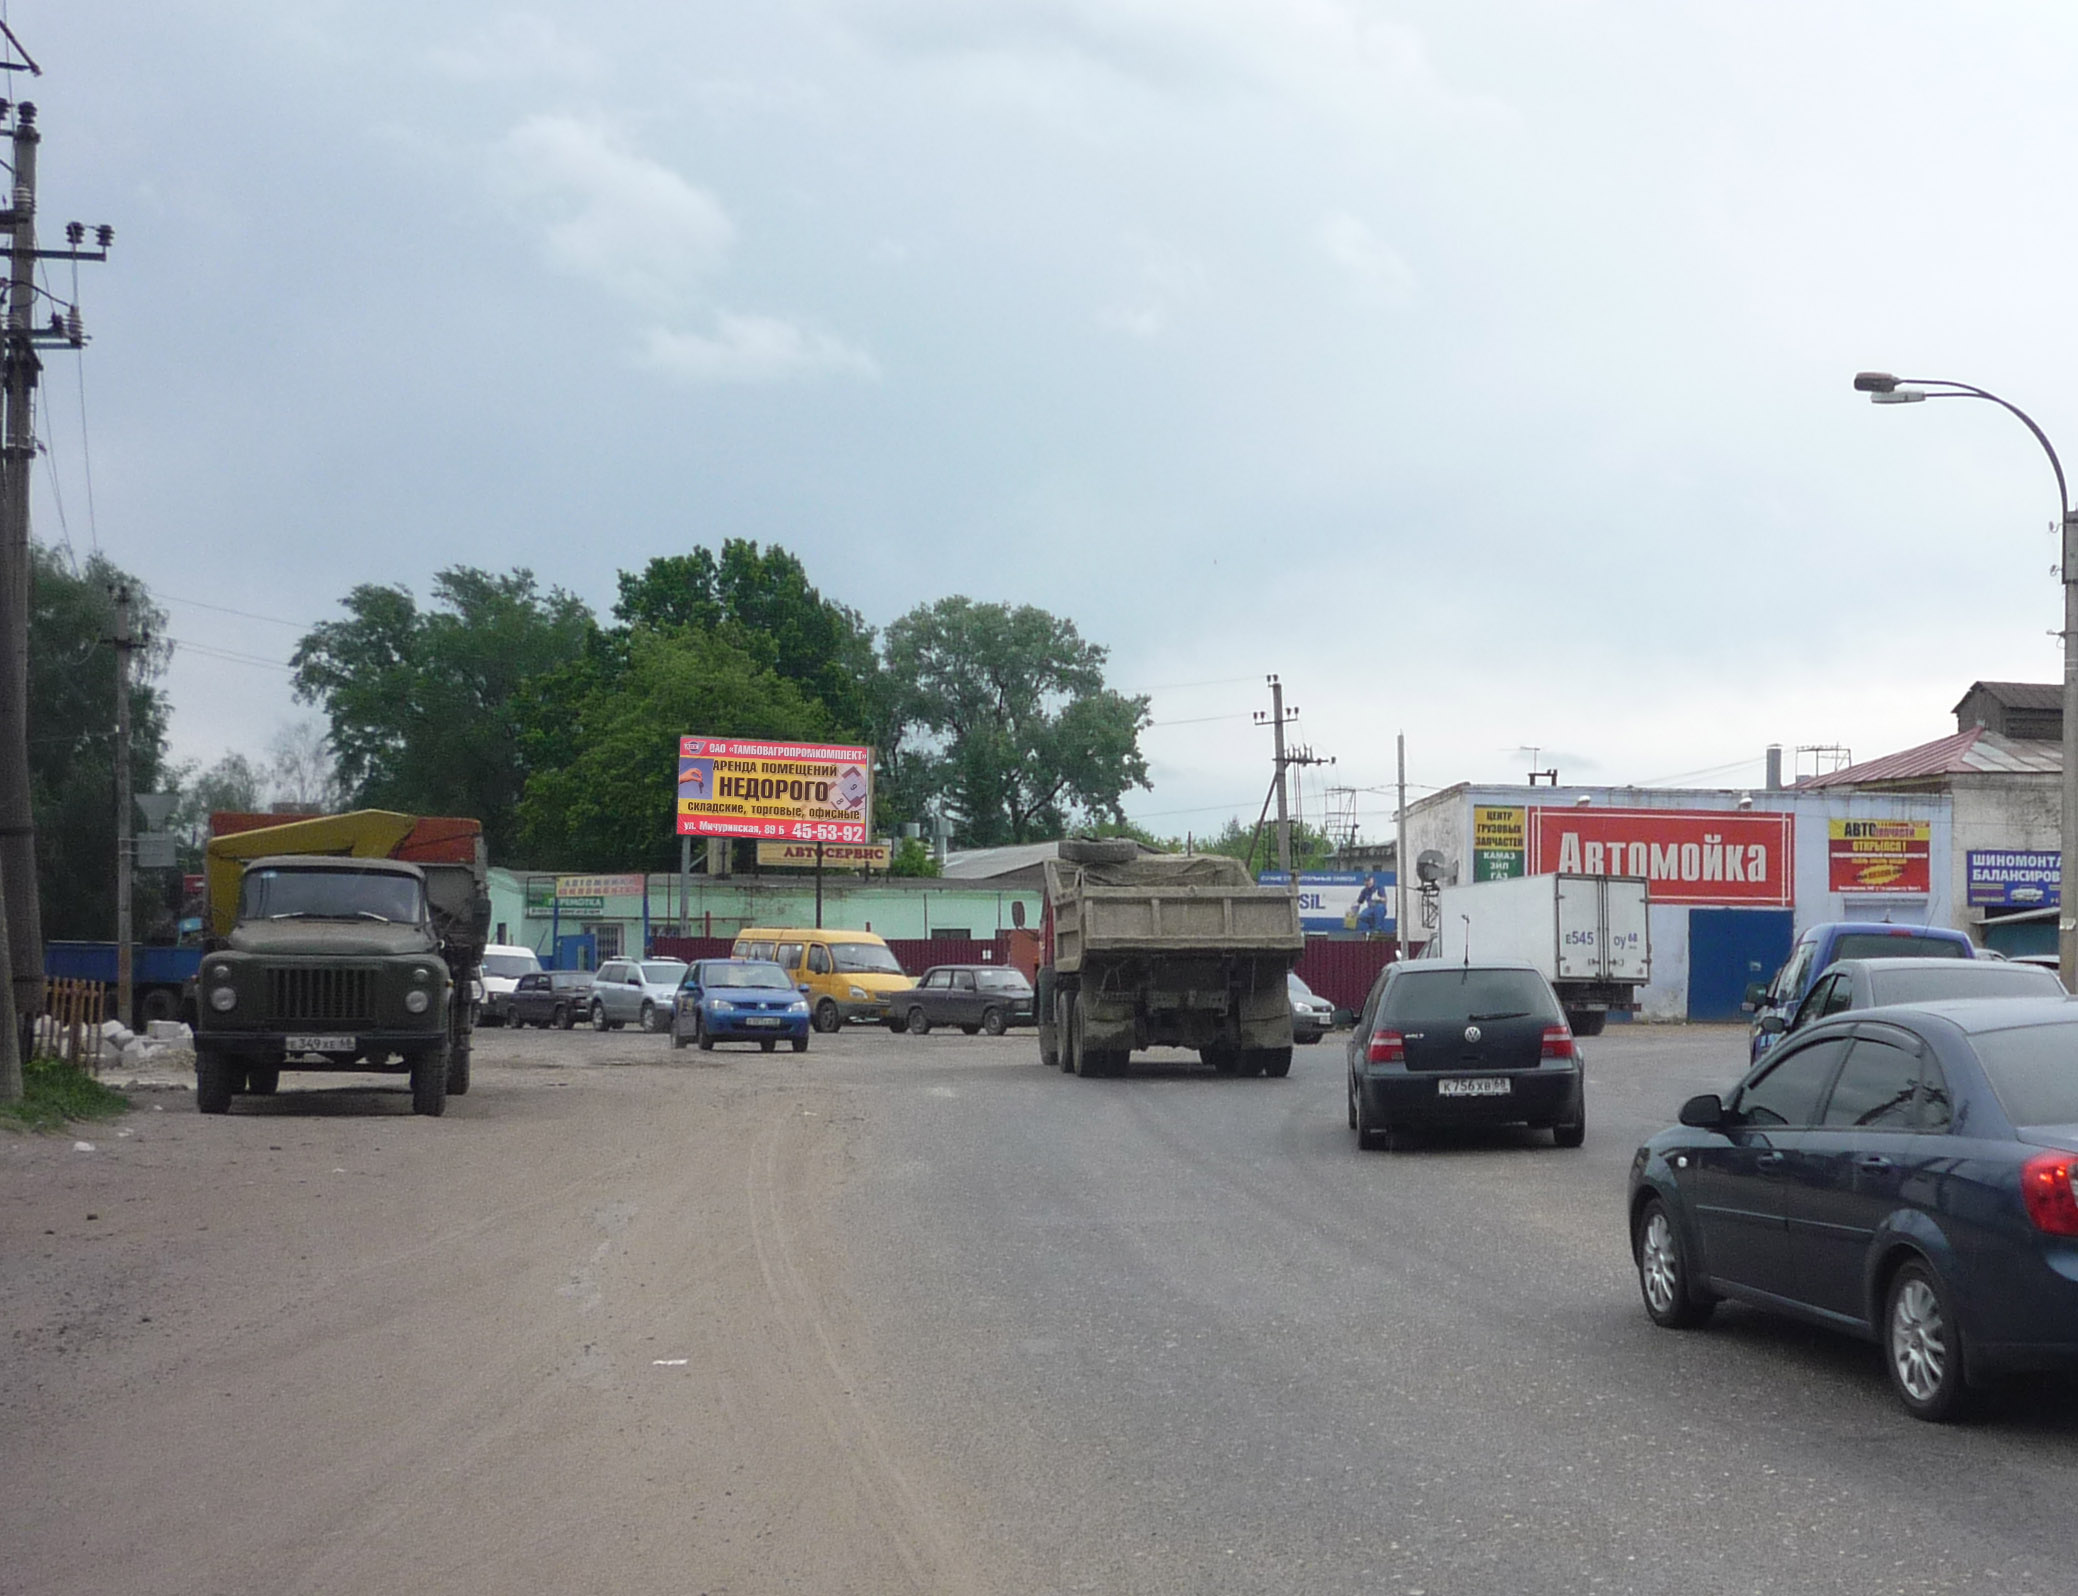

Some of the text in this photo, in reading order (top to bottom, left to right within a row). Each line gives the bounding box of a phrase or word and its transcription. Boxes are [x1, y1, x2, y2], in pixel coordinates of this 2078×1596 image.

[709, 743, 867, 760] ОАО «ТАМБОВАГРОПРОМКОМПЛЕКТ»
[713, 760, 837, 776] АРЕНДА ПОМЕЩЕНИЙ
[719, 776, 829, 801] НЕДОРОГО
[687, 801, 860, 820] складские, торговые, офисные
[1487, 811, 1513, 820] ЦЕНТР
[684, 822, 696, 830] ул.
[699, 821, 761, 835] Мичуринская,
[764, 825, 775, 835] 89
[792, 823, 863, 842] 45-53-92
[1477, 824, 1522, 833] ГРУЗОВЫХ
[1483, 851, 1516, 860] КАМАЗ
[1491, 872, 1508, 880] ГАЗ
